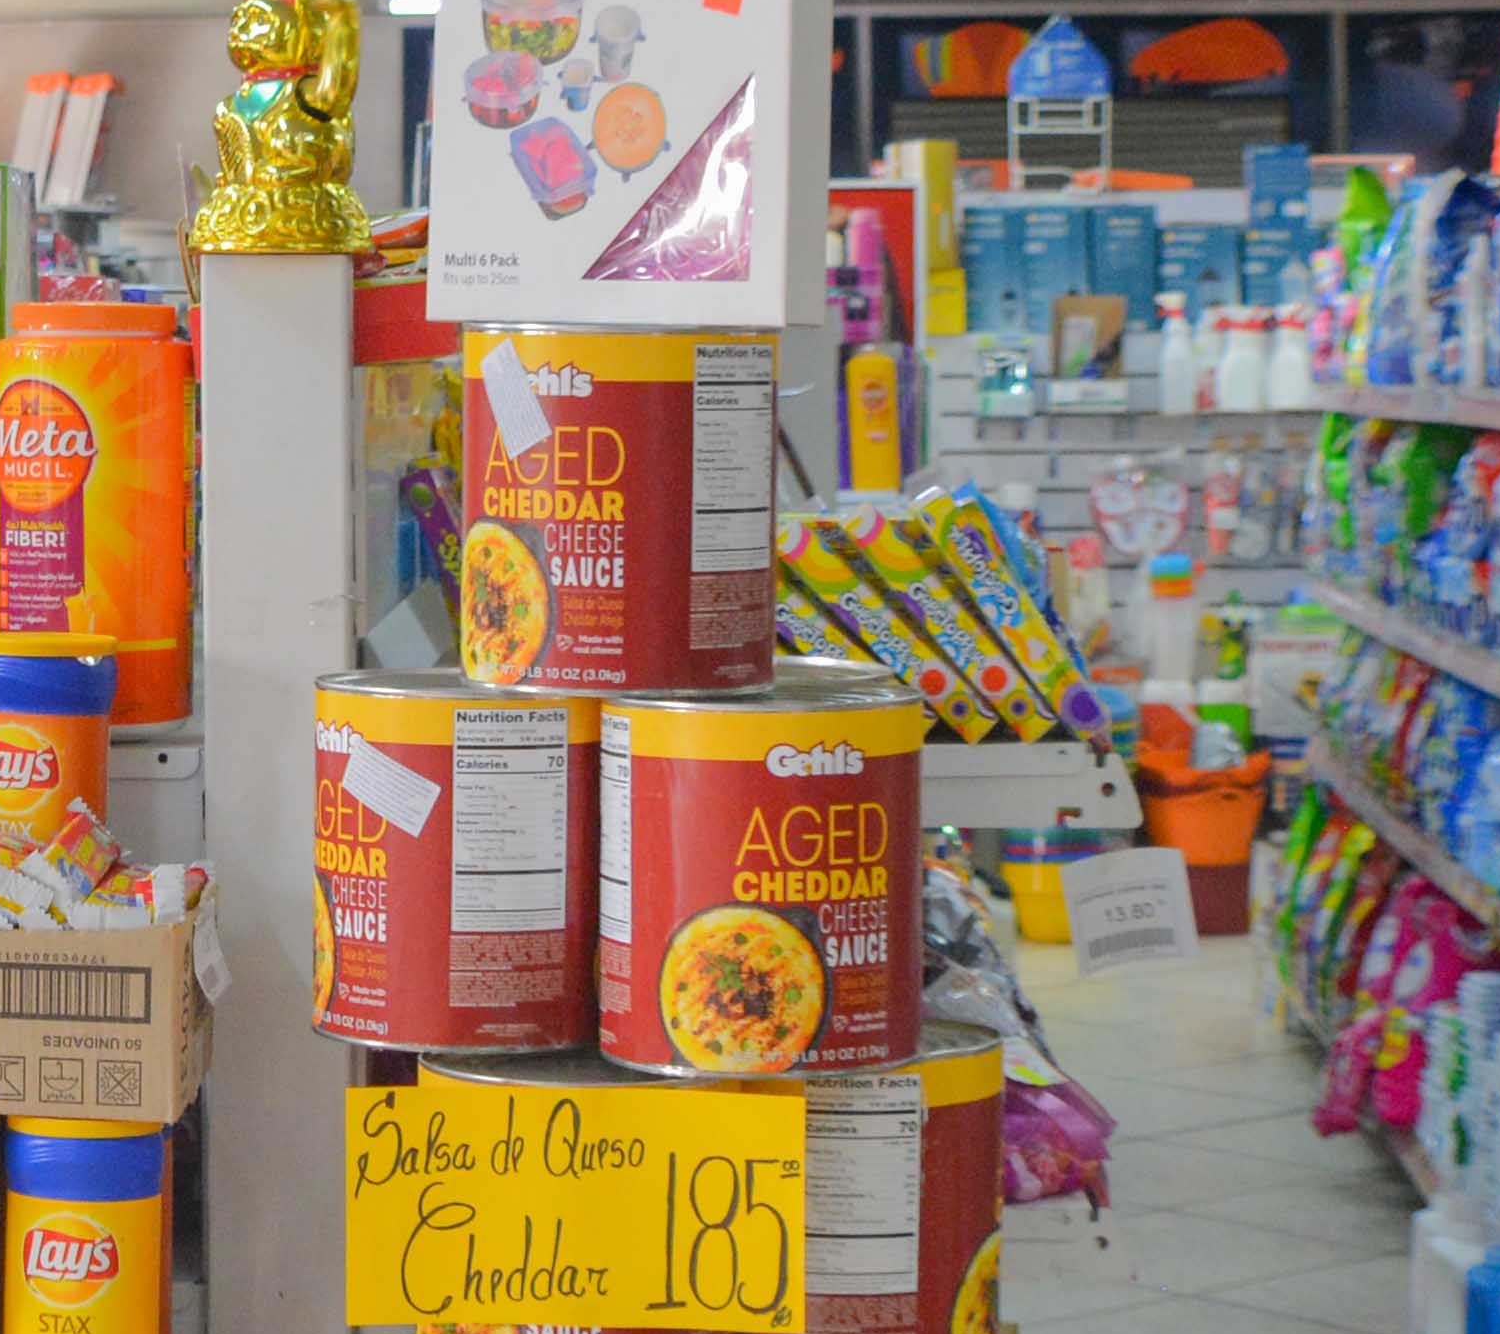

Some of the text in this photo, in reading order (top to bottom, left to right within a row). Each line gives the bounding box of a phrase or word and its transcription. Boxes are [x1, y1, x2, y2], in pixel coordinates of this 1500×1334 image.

[444, 254, 520, 267] Multi 6 Pack
[442, 273, 520, 287] fits up to 25cm
[4, 462, 66, 478] MUCIL
[485, 425, 626, 486] AGED
[483, 486, 624, 521] CHEDDAR
[6, 530, 66, 547] FIBER!
[544, 523, 624, 554] CHEESE
[550, 557, 624, 588] SAUCE
[562, 668, 580, 679] OZ
[456, 711, 565, 724] Nutrition Facts
[456, 755, 565, 769] Calories 70
[765, 739, 866, 778] Gehl's
[735, 802, 889, 867] AGED
[332, 876, 388, 911] CHEESE
[732, 866, 888, 903] CHEDDAR
[334, 911, 388, 943] SAUCE
[818, 899, 889, 934] CHEESE
[825, 932, 888, 968] SAUCE
[41, 1034, 142, 1051] 50 UNIDADES
[355, 1091, 646, 1198] Salsa de Queso
[25, 1229, 114, 1281] Lay's
[400, 1181, 609, 1317] Cheddar
[38, 1313, 93, 1334] STAX
